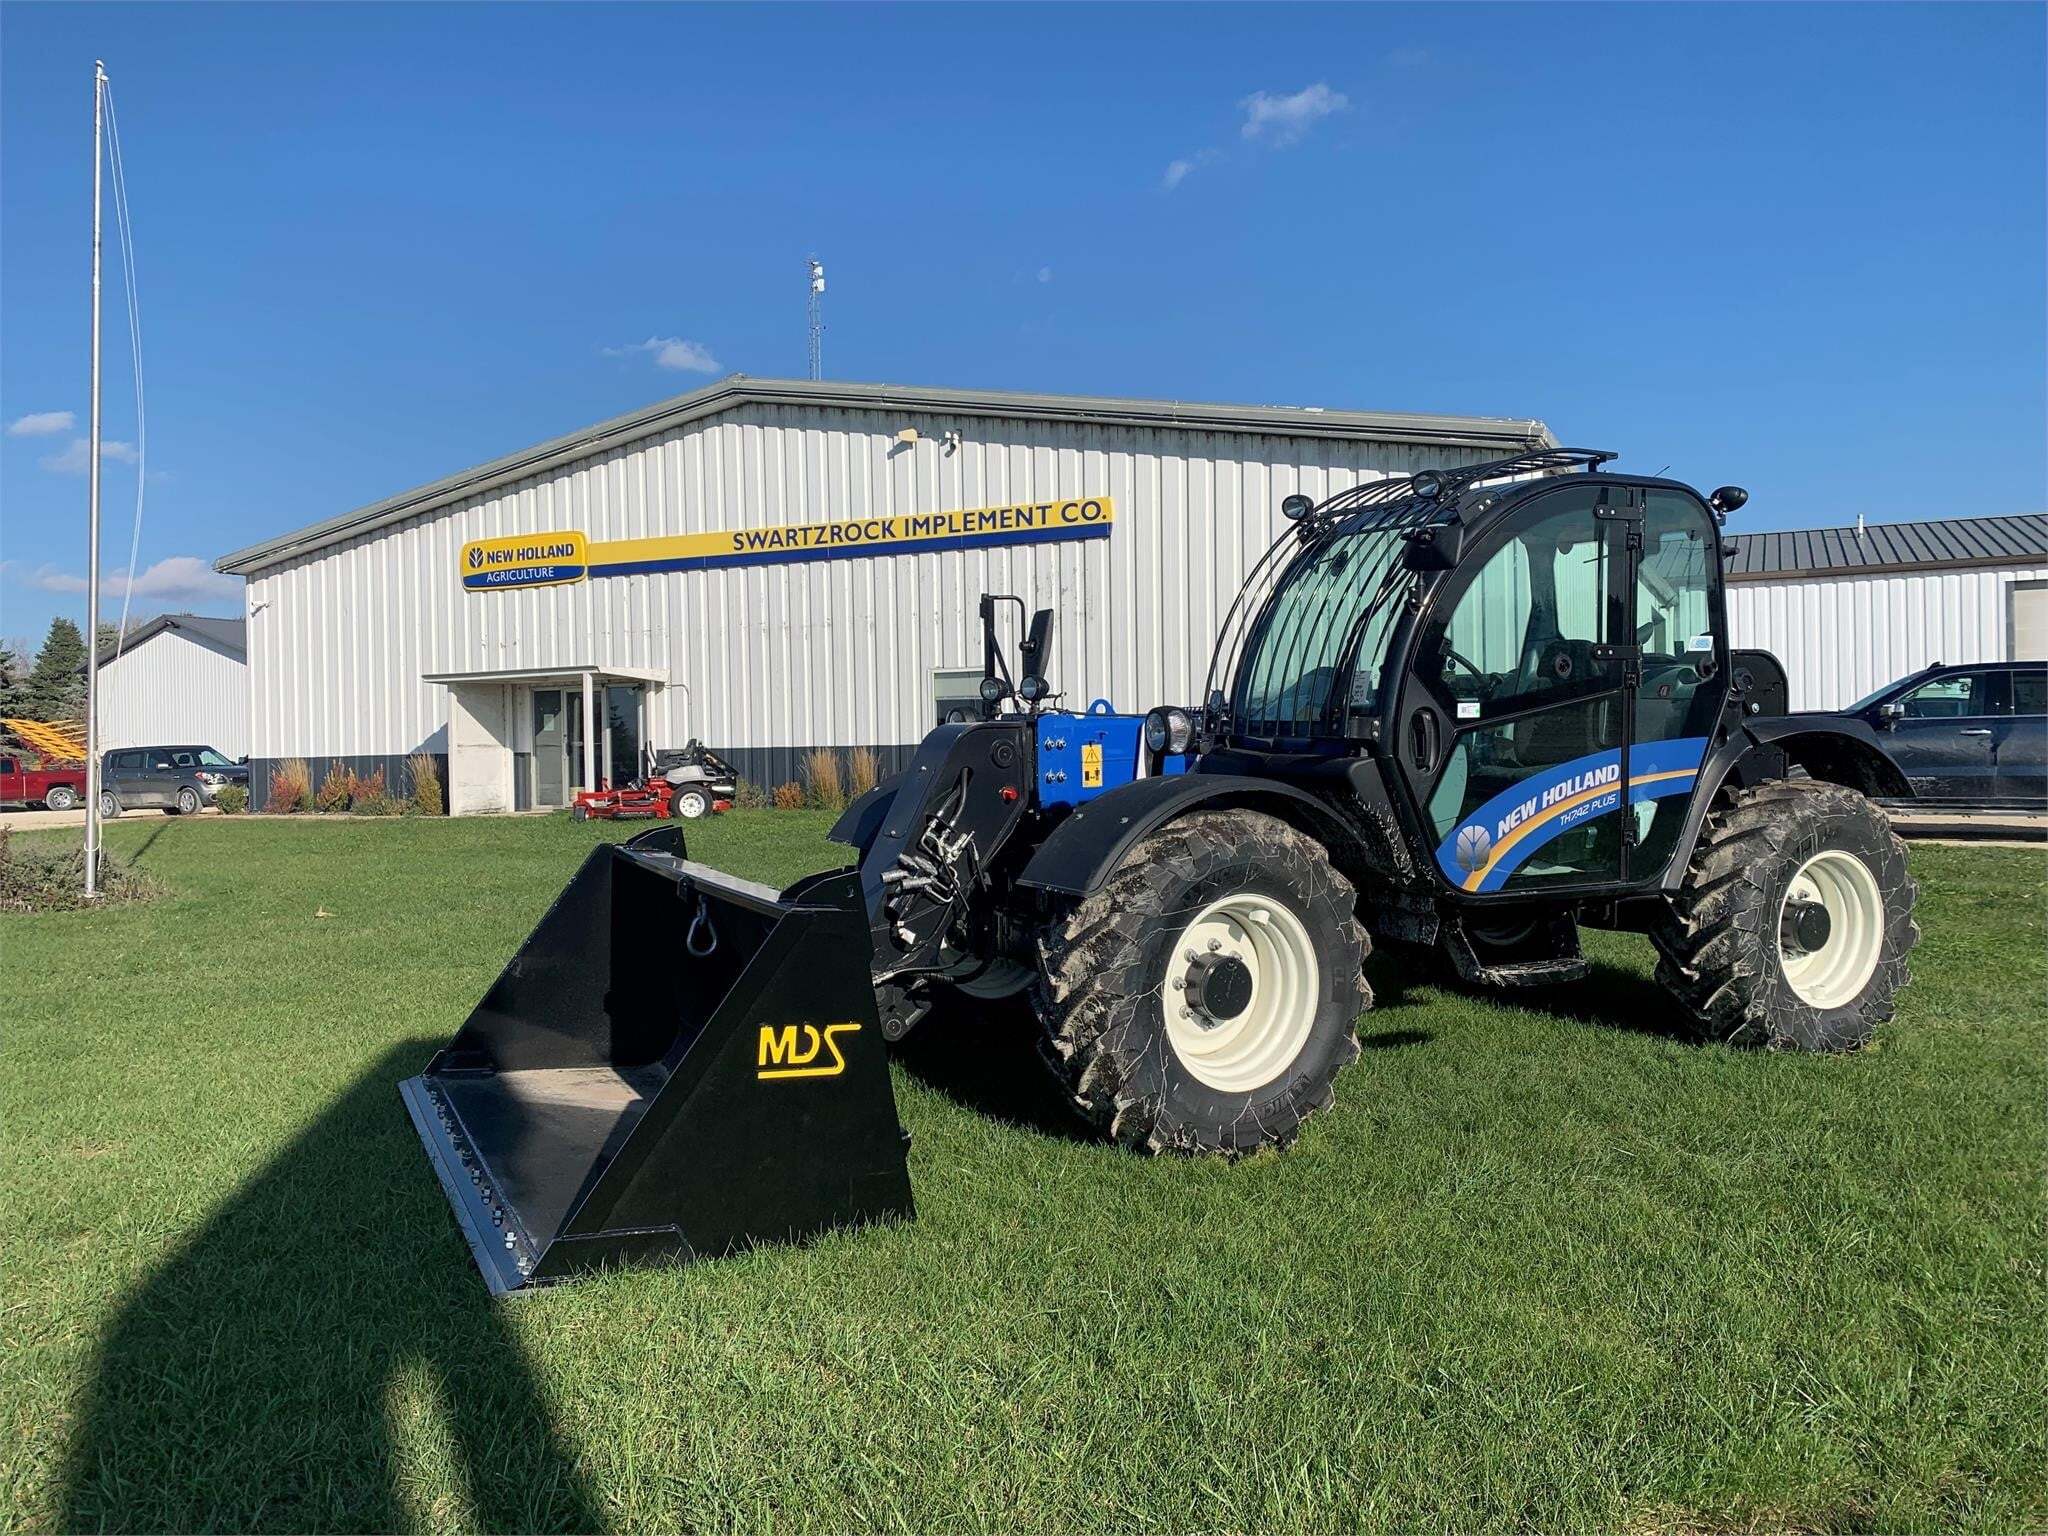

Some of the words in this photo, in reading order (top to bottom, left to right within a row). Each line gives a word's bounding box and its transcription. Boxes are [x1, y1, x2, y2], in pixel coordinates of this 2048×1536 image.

[733, 519, 897, 551] SWARTZROCK
[904, 504, 1053, 537] IMPLEMENT
[1060, 500, 1108, 523] CO.
[486, 548, 514, 565] NEW
[516, 543, 575, 562] HOLLAND
[486, 566, 555, 583] AGRICULTURE
[1497, 796, 1538, 840] NEW
[1541, 763, 1620, 809] HOLLAND
[1591, 793, 1617, 812] PLUS
[757, 1023, 862, 1079] MDS
